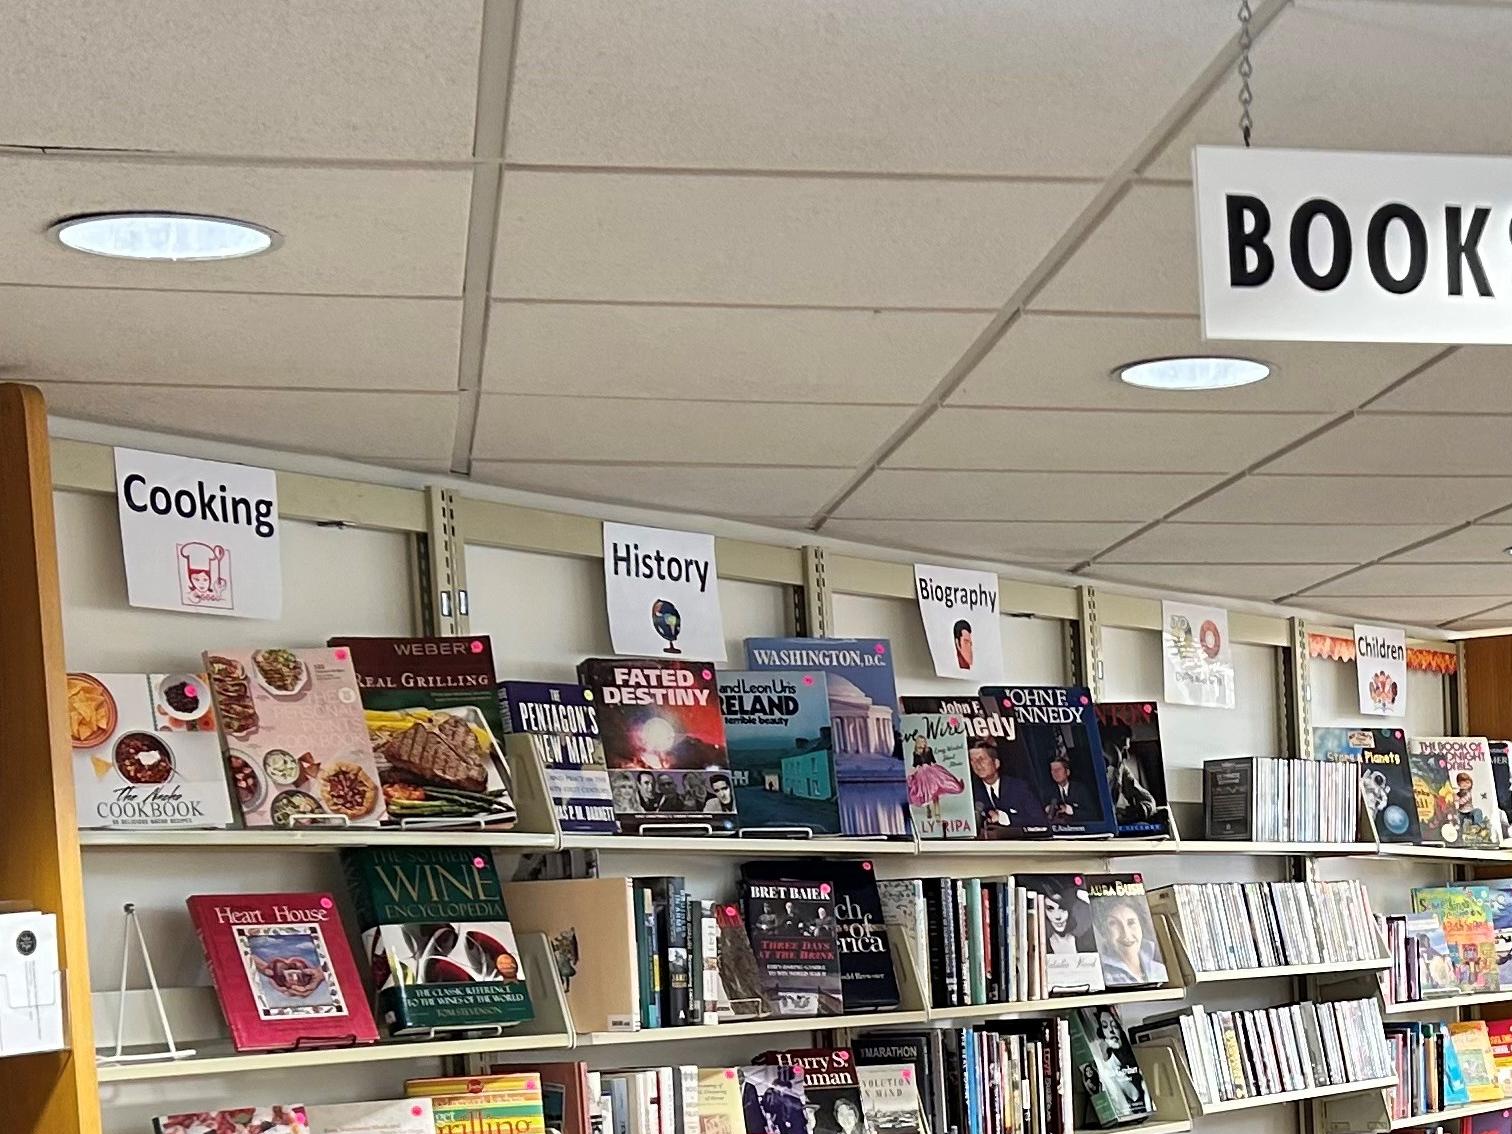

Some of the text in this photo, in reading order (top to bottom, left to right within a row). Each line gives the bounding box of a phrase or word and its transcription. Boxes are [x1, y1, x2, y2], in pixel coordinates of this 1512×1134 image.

[123, 473, 275, 538] Cooking
[612, 542, 709, 593] History
[918, 577, 997, 614] Biography
[1357, 635, 1405, 661] Children
[401, 672, 489, 688] GRILLING
[613, 667, 694, 688] FATED
[602, 686, 710, 706] DESTINY
[566, 736, 596, 765] MAP
[97, 800, 205, 819] COOKBOOK
[374, 864, 500, 903] WINE
[750, 885, 788, 900] BRET
[214, 905, 330, 924] Heart House
[384, 902, 504, 919] ENCYCLOPEDIA
